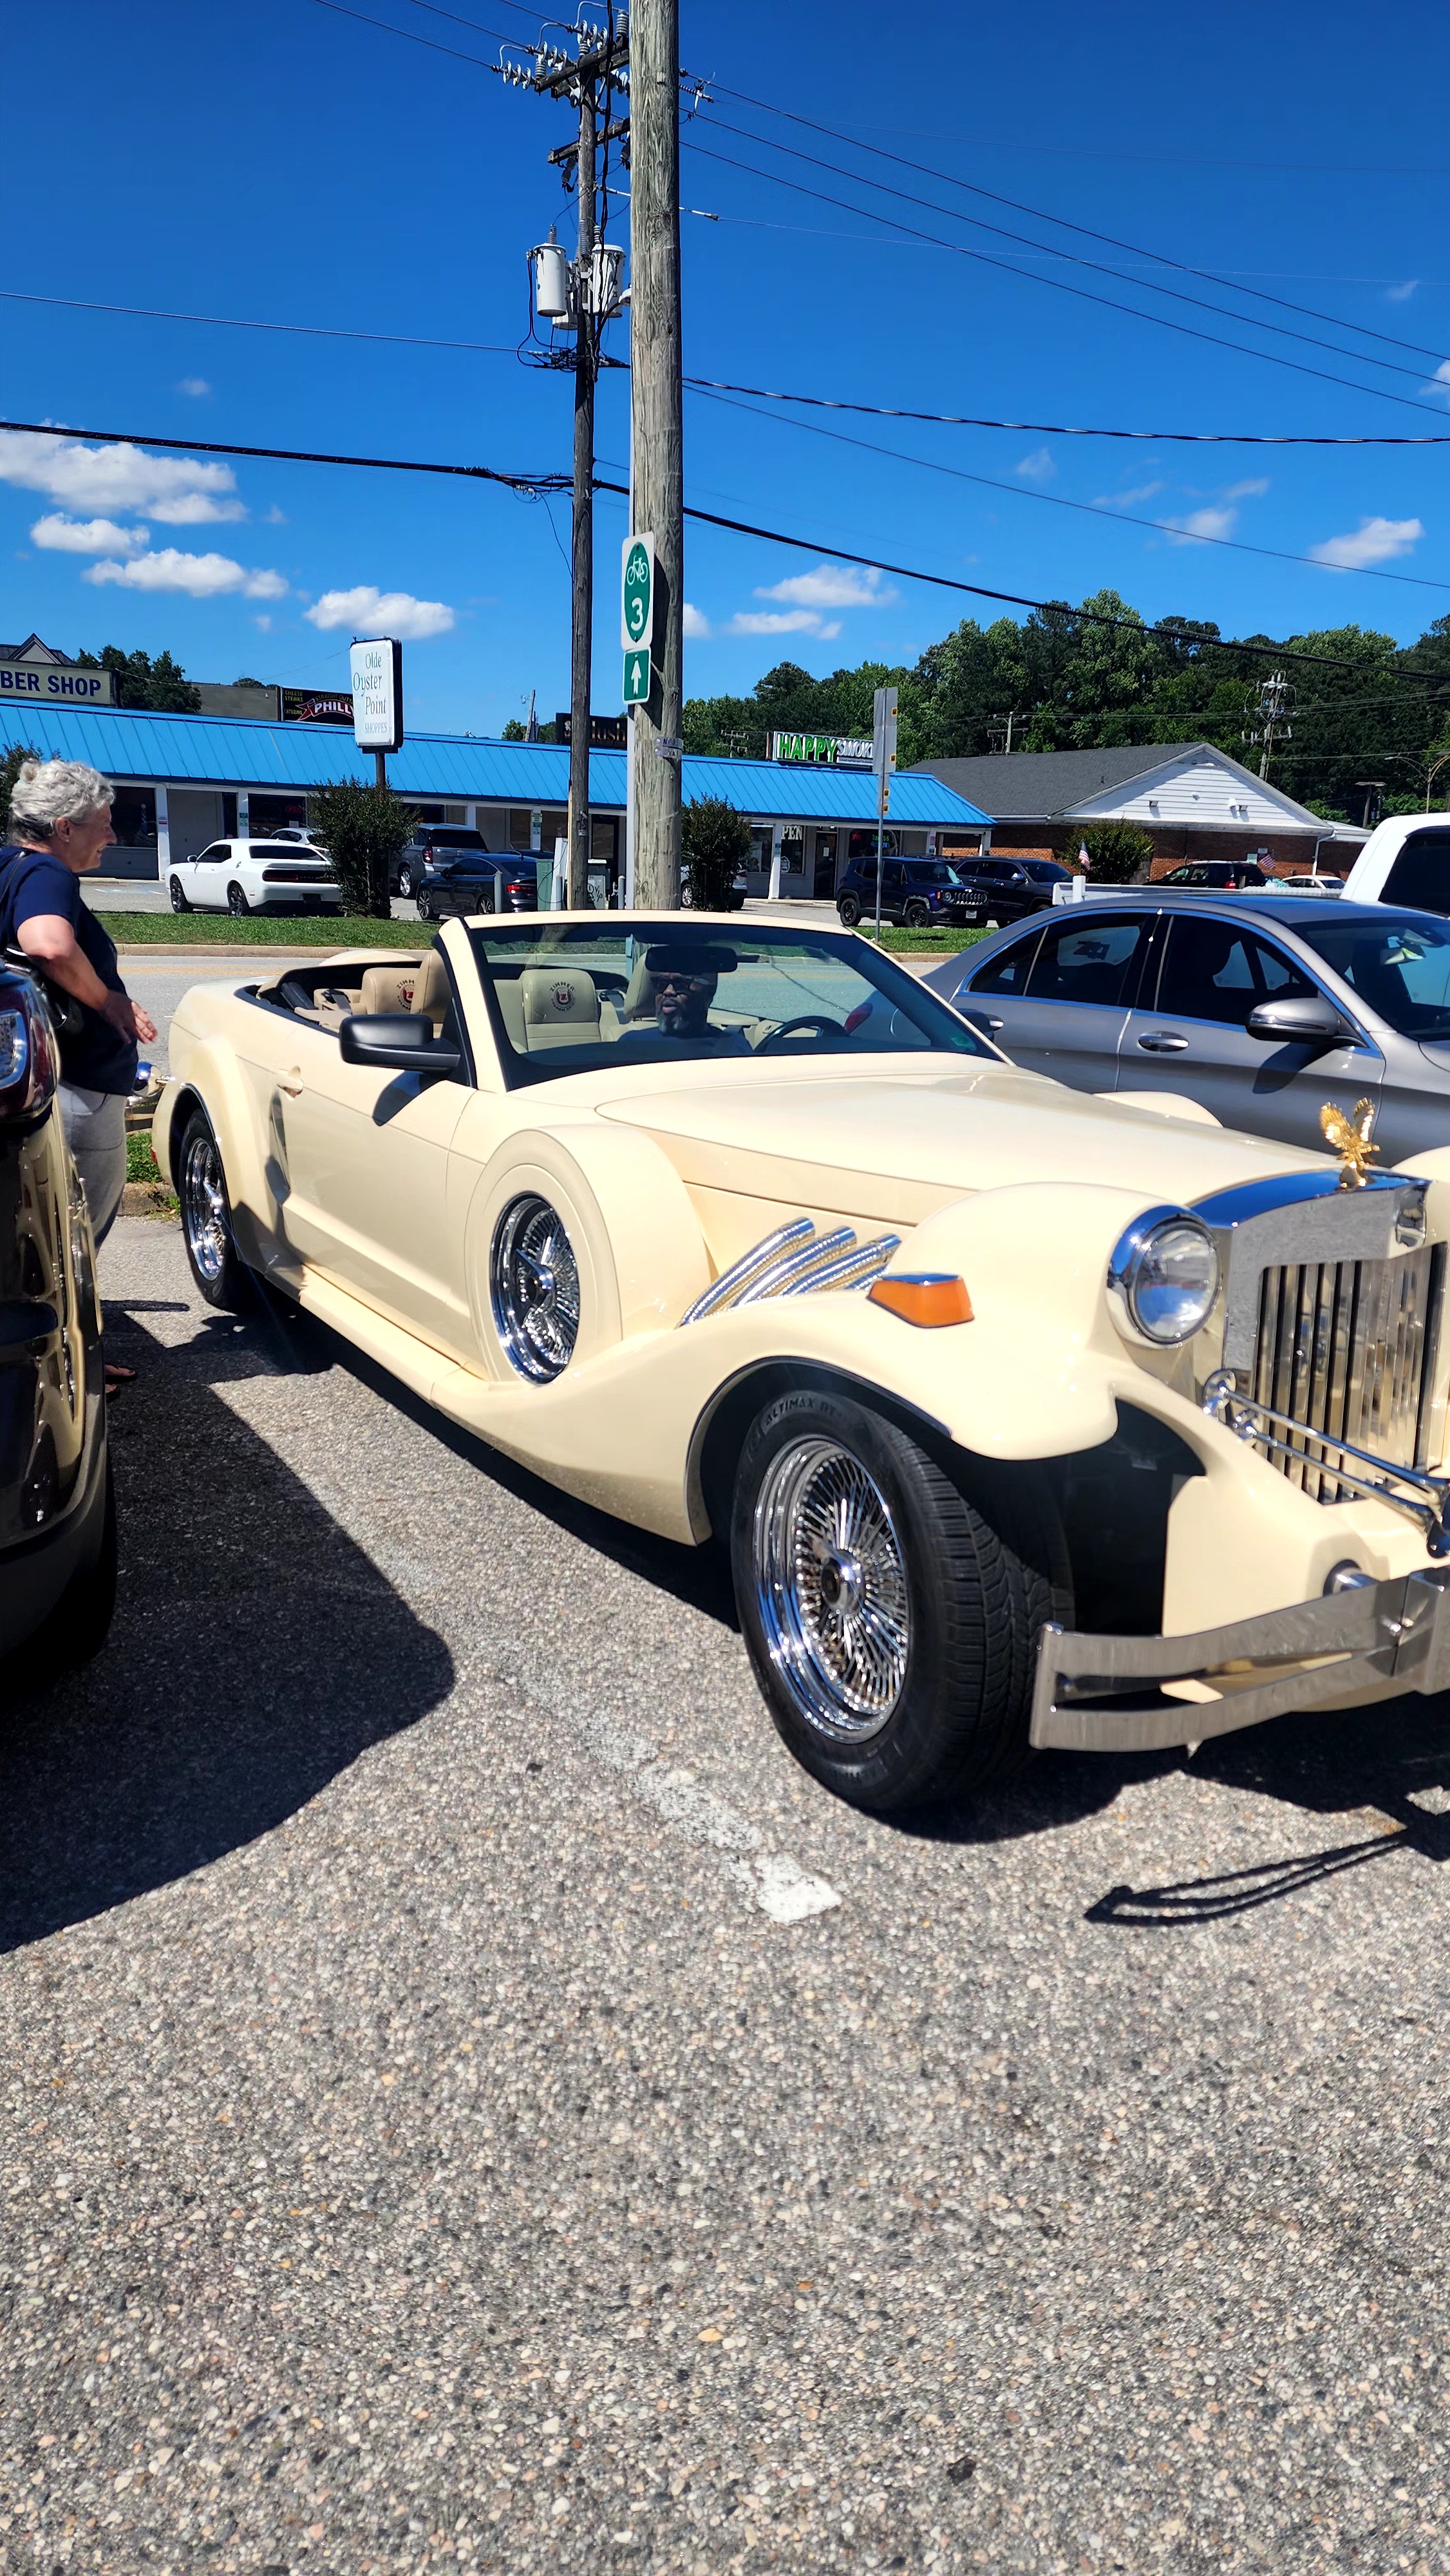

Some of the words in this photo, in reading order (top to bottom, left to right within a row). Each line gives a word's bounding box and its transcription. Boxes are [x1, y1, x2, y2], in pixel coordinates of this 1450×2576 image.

[631, 597, 643, 630] 3
[365, 652, 382, 669] Olde
[0, 670, 41, 692] BER
[48, 675, 101, 697] SHOP
[353, 672, 382, 697] Oyster
[315, 693, 338, 702] STRAIGHT
[365, 696, 387, 715] Point
[364, 722, 388, 734] SHOPPES
[592, 721, 626, 742] lush
[777, 734, 837, 763] HAPPY
[781, 826, 803, 840] PEN
[396, 979, 415, 989] ZIMM
[549, 981, 575, 992] ZIMMER
[766, 1397, 815, 1426] ALTIMAX
